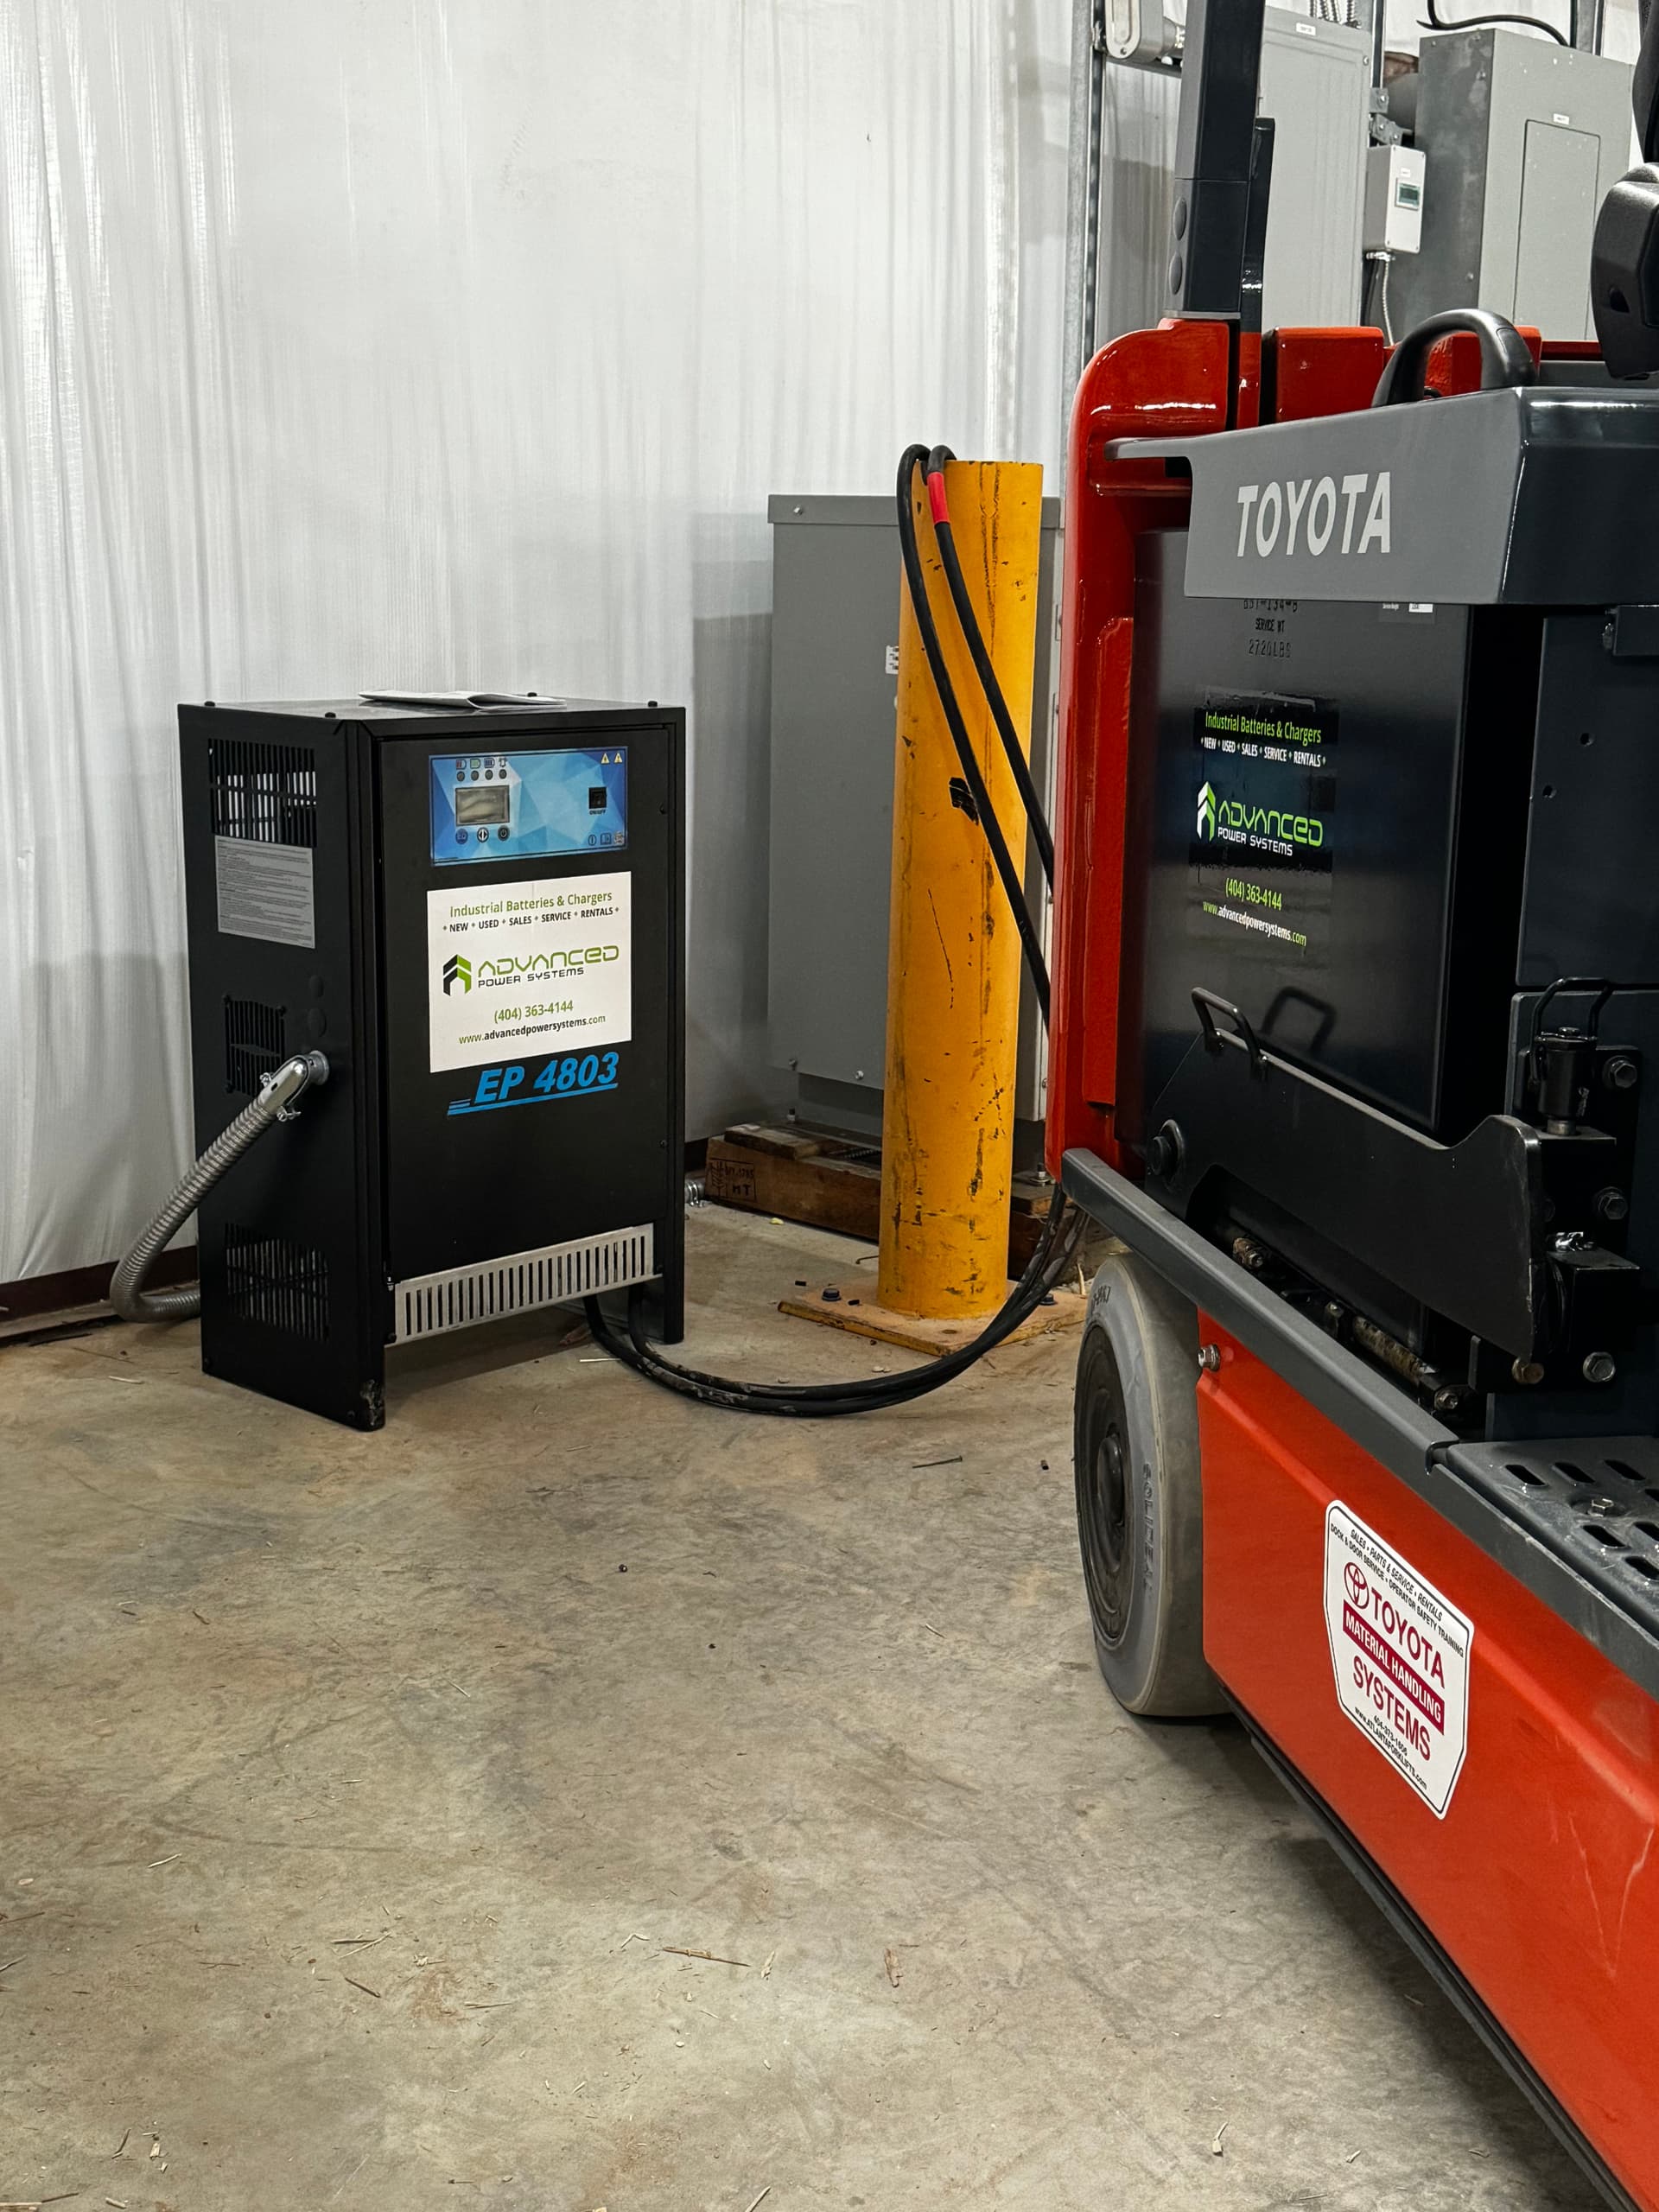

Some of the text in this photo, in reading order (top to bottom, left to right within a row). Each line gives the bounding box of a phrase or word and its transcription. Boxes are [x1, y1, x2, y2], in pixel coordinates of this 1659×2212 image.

[1237, 471, 1390, 557] TOYOTA
[1205, 711, 1322, 747] Industrial Batteries & Chargers
[1204, 737, 1321, 767] NEW USED SALES SERVICE RENTALS
[1217, 826, 1294, 856] POWER SYSTEMS
[1218, 800, 1323, 848] ADVANCED
[450, 892, 613, 918] Industrial Batteries & Chargers
[1225, 877, 1282, 911] (404) 363-4144
[449, 907, 613, 933] NEW USED SALES SERVICE RENTALS
[1203, 901, 1306, 946] www.advancedpowersystems.com
[478, 945, 620, 977] ADVANCED
[478, 967, 584, 988] POWER SYSTEMS
[458, 1014, 606, 1045] www.advancedpowersystems.com
[493, 1000, 574, 1024] (404) 363-4144
[474, 1052, 620, 1104] EP 4803
[1331, 1523, 1344, 1542] DOCK
[1349, 1540, 1363, 1560] DOOR
[1363, 1554, 1384, 1581] SERVICE
[1389, 1579, 1416, 1609] OPERATOR
[1417, 1605, 1437, 1630] SAFETY
[1438, 1626, 1465, 1658] TRAINING
[1351, 1529, 1443, 1622] SALES PARTS & SERVICE RENTALS
[1371, 1586, 1446, 1689] TOYOTA
[1345, 1610, 1441, 1723] MATERIAL HANDLING
[1353, 1656, 1431, 1761] SYSTEMS
